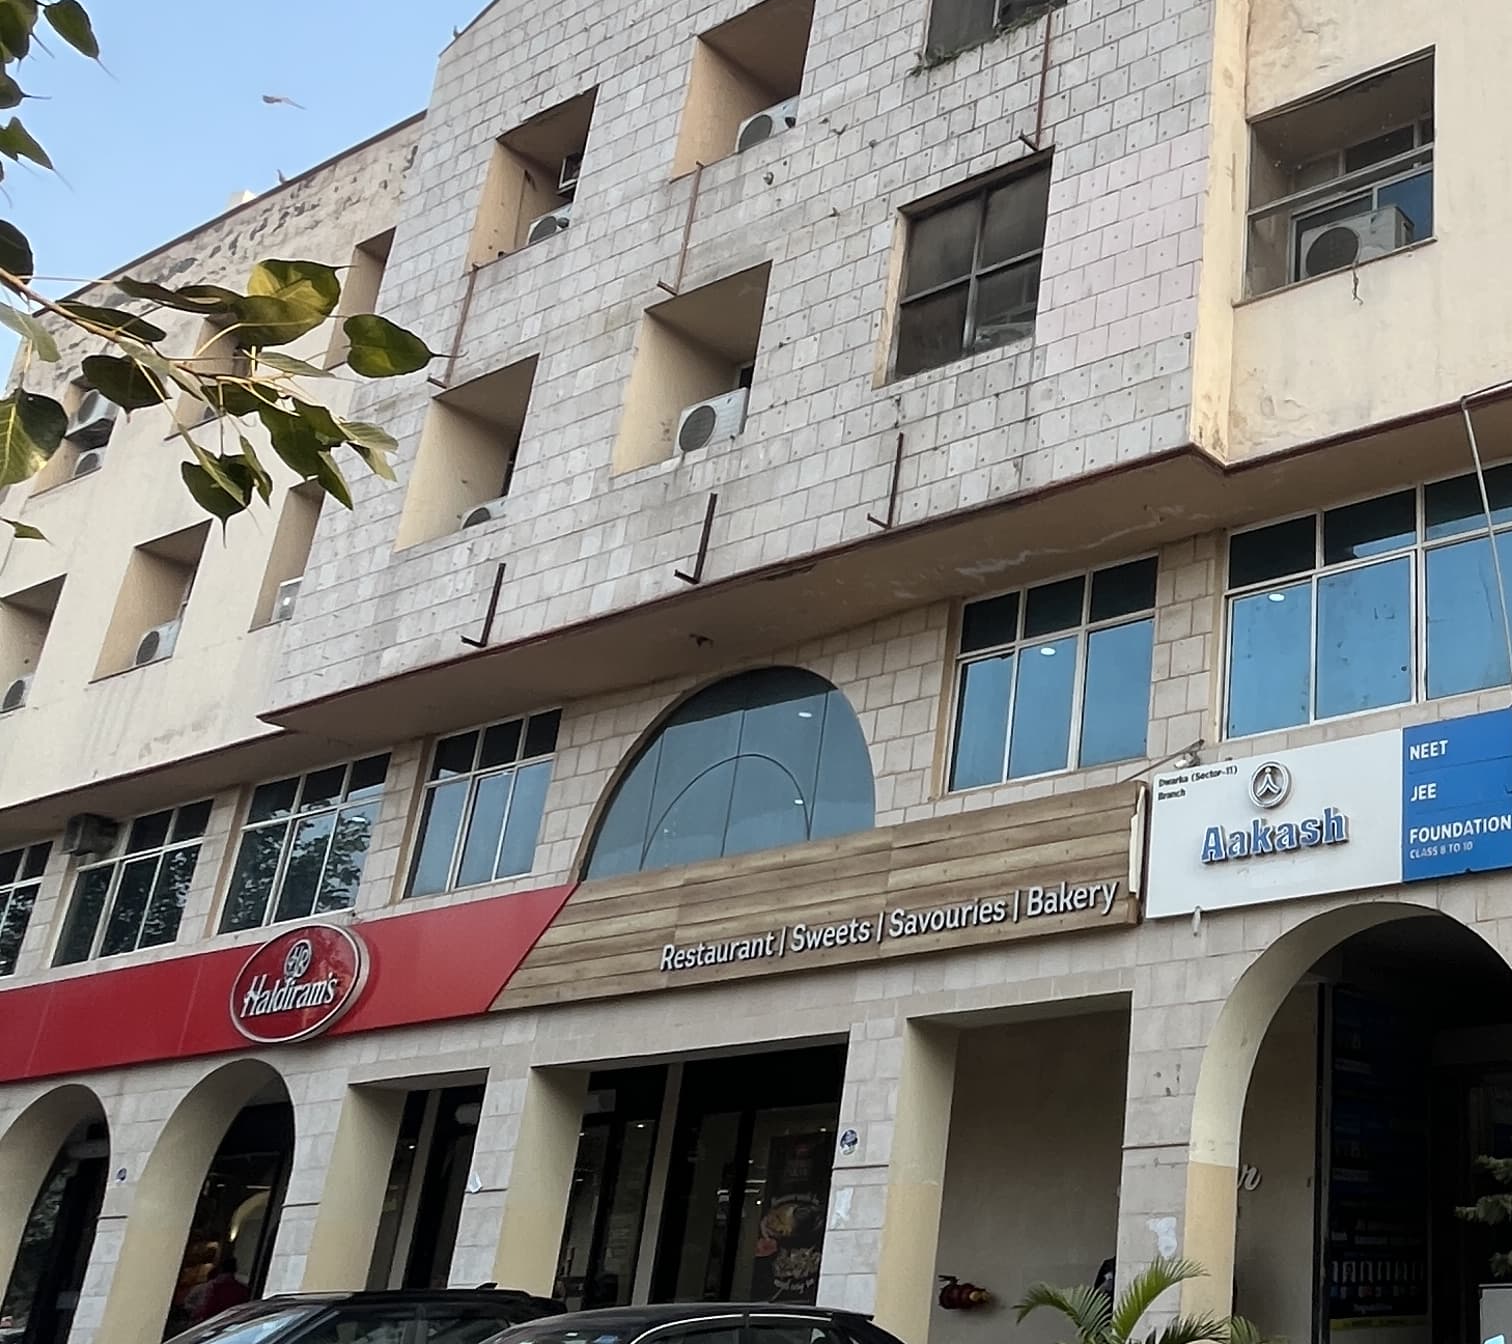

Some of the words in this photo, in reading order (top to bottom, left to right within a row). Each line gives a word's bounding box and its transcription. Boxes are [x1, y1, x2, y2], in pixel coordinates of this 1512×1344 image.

[1409, 739, 1449, 761] NEET
[1157, 788, 1186, 801] Branch
[1410, 783, 1437, 802] JEE
[1200, 806, 1350, 864] Aakash
[1409, 813, 1512, 845] FOUNDATION
[1409, 844, 1438, 859] CLASS
[1448, 842, 1461, 854] TO
[659, 933, 776, 972] Restaurant
[789, 917, 873, 953] Sweets
[887, 896, 1007, 940] Savouries
[1026, 879, 1120, 918] Bakery
[240, 970, 338, 1019] Haldiram's
